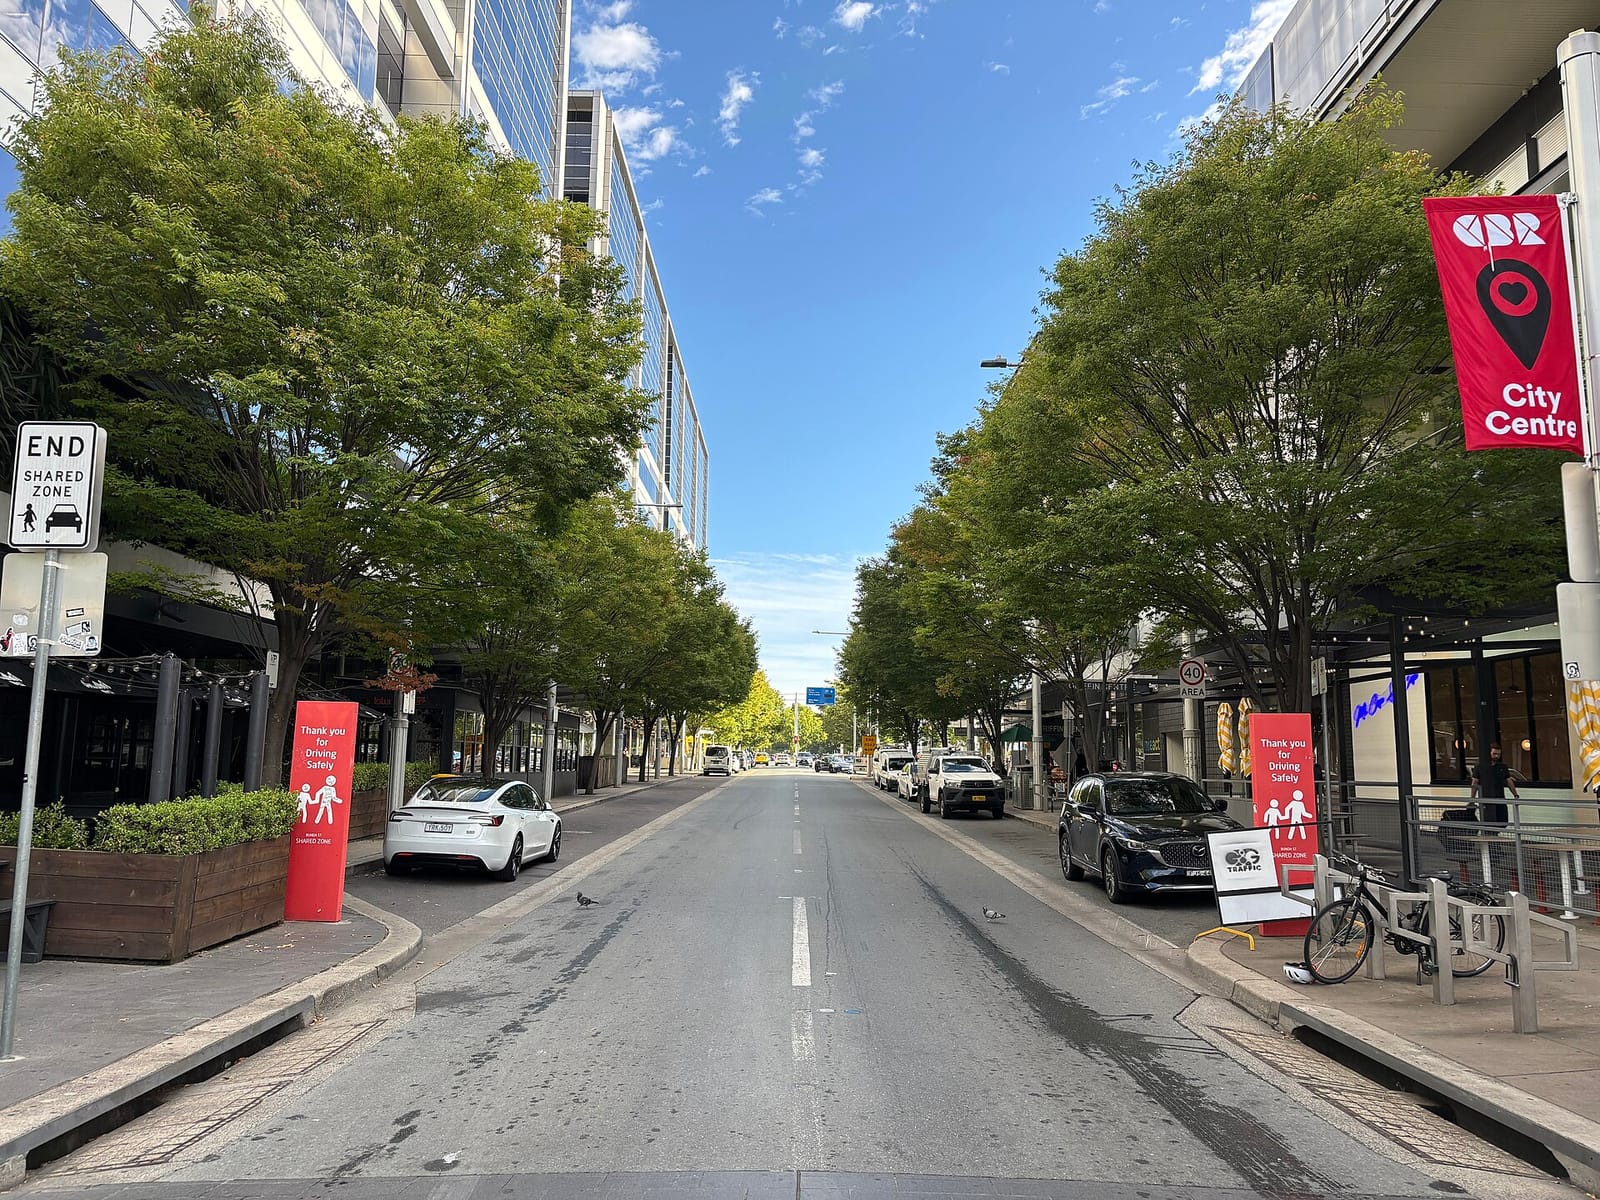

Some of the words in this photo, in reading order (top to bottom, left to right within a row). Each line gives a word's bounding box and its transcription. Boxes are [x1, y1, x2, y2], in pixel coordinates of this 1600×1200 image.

[1453, 212, 1546, 247] CBR
[1502, 383, 1562, 414] City
[1485, 410, 1577, 439] Centre
[27, 435, 85, 457] END
[24, 470, 84, 482] SHARED
[32, 485, 72, 497] ZONE
[1184, 667, 1201, 679] 40
[1182, 688, 1205, 696] AREA
[301, 726, 327, 735] Thank
[329, 728, 346, 736] you
[316, 737, 328, 746] for
[1260, 738, 1288, 747] Thank
[1290, 740, 1306, 749] you
[305, 748, 337, 760] Driving
[1278, 749, 1290, 759] for
[307, 760, 334, 771] Safely
[1269, 762, 1301, 772] Driving
[1271, 773, 1299, 784] Safely
[1227, 864, 1262, 873] TRAFFIC
